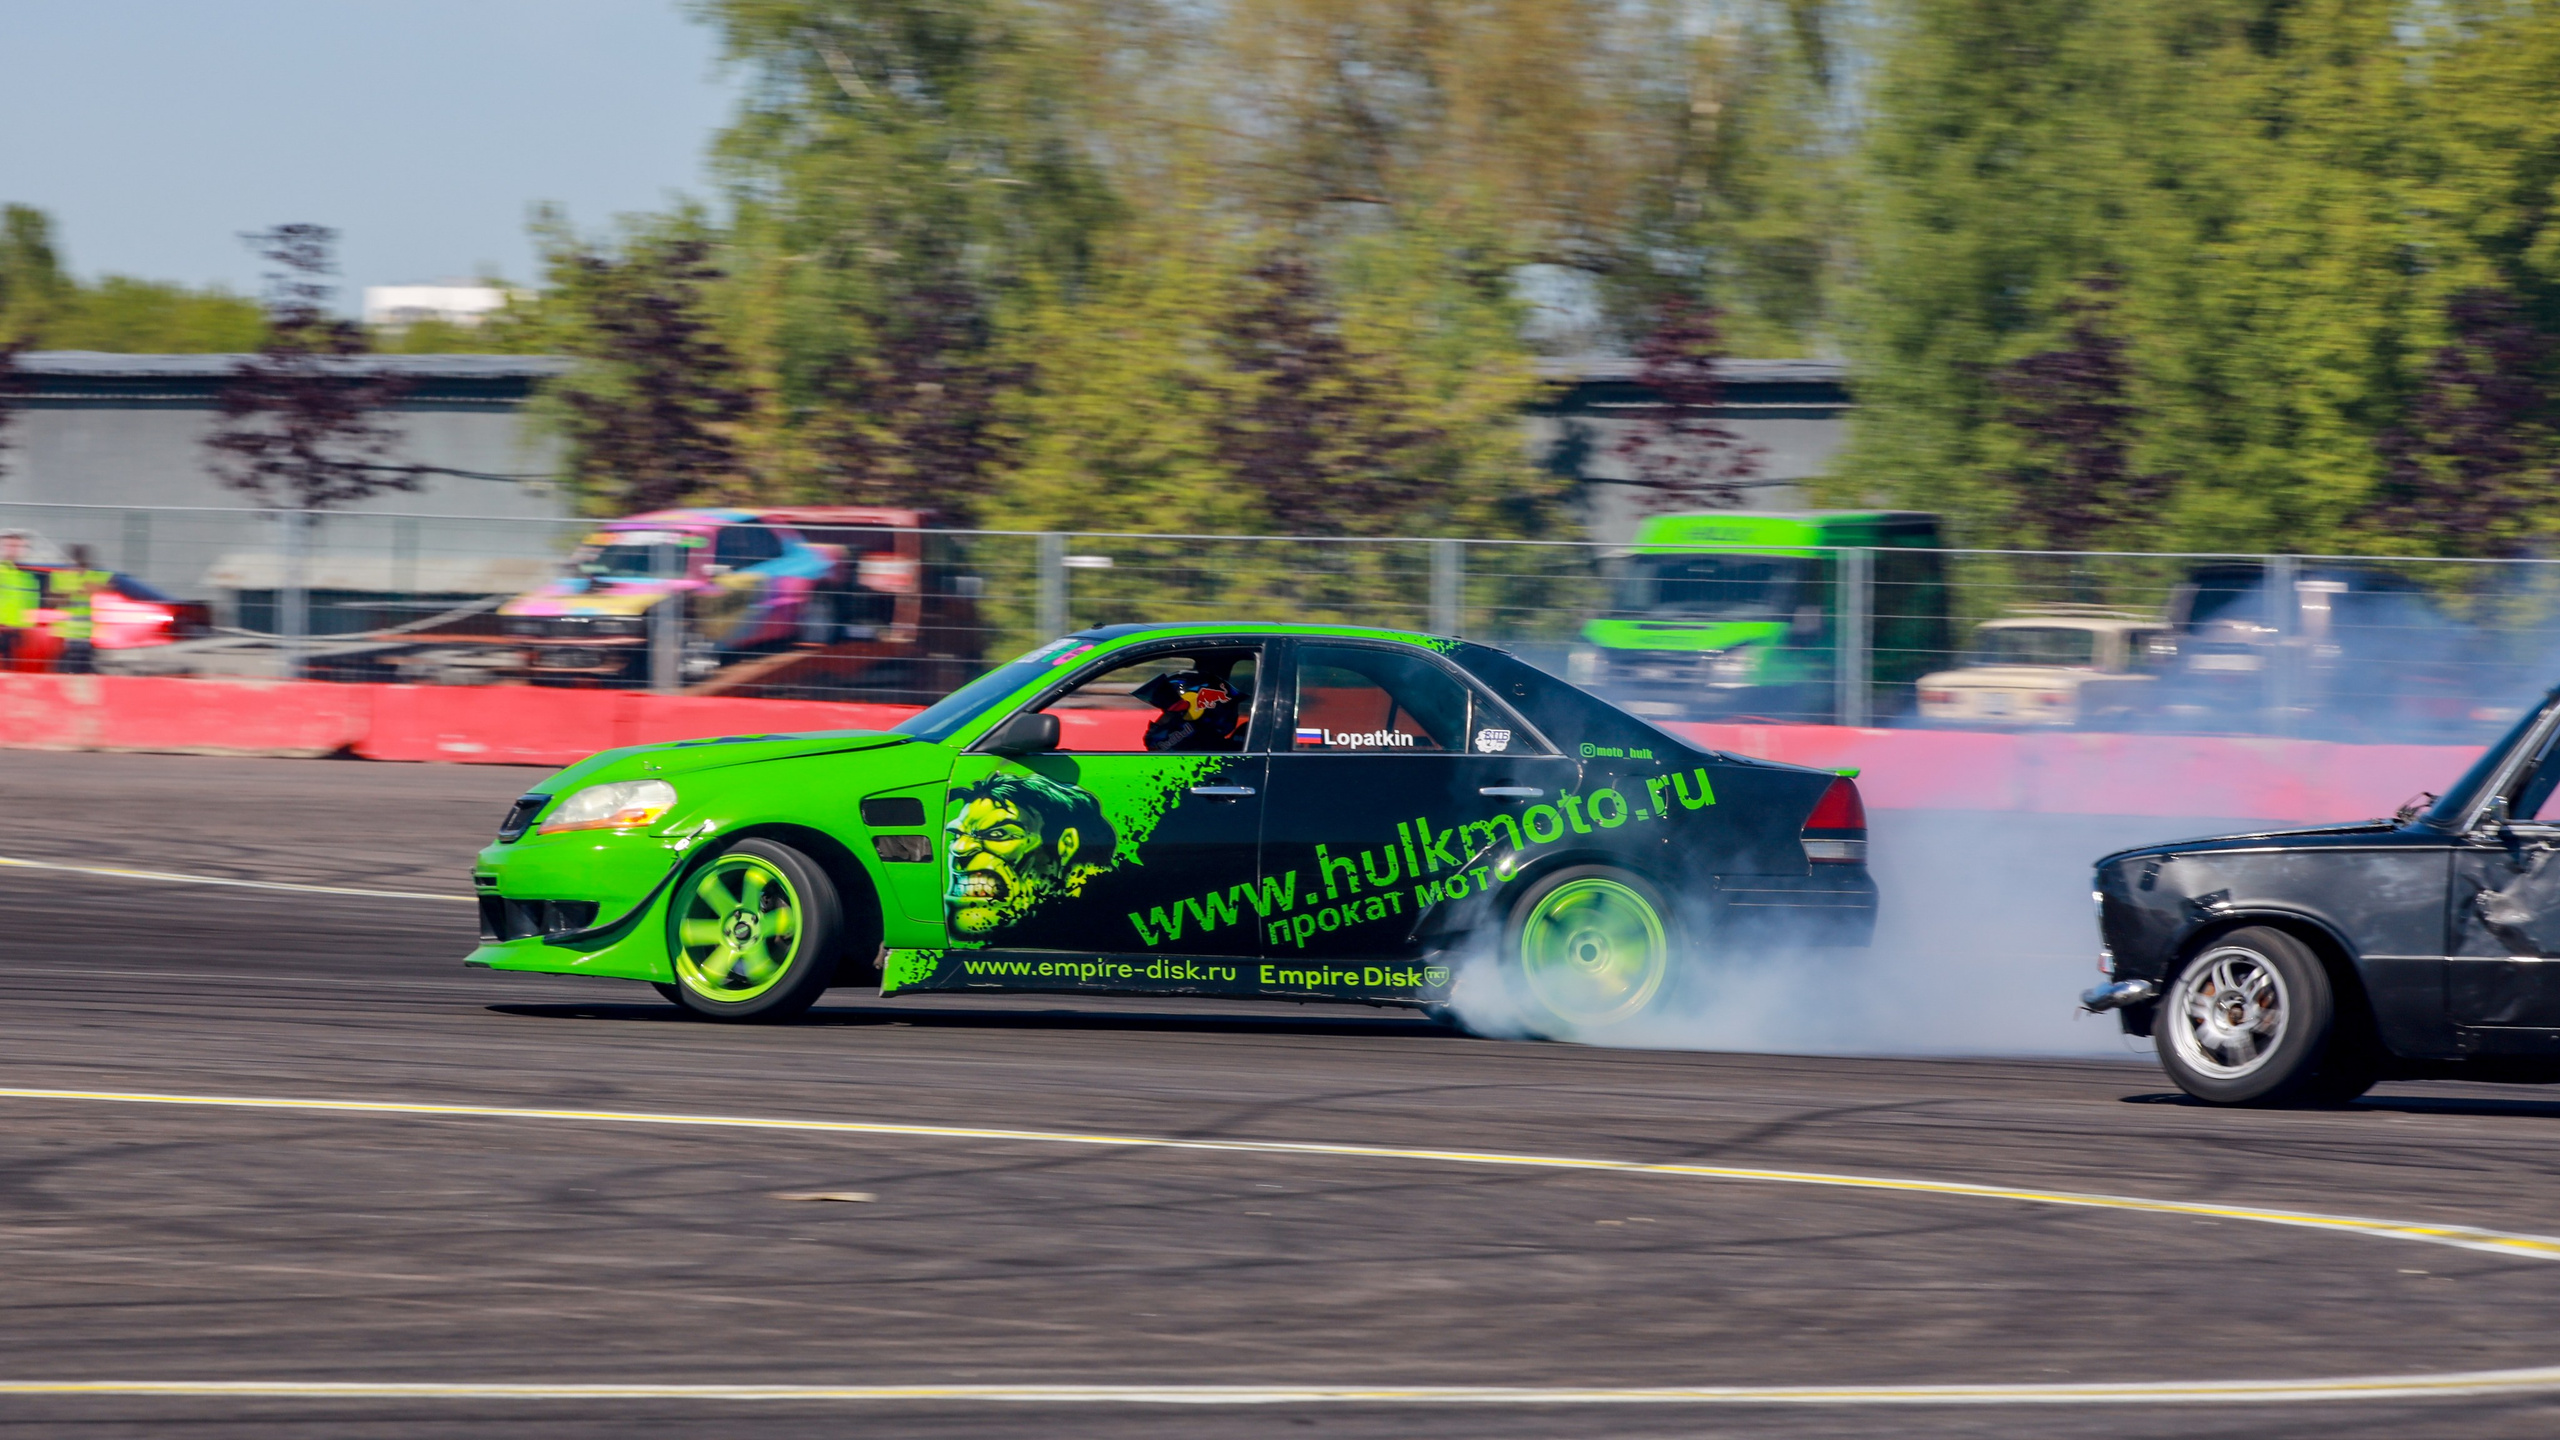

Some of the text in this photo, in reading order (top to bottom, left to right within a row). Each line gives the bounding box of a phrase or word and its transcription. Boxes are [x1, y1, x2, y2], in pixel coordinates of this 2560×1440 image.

[1323, 728, 1414, 750] Lopatkin
[1596, 746, 1654, 760] moto_hulk
[1129, 766, 1716, 947] www.hulkmoto.ru
[1268, 859, 1519, 949] прокат мото
[964, 958, 1236, 981] www.empire-disk.ru
[1260, 965, 1423, 989] Empire Disk
